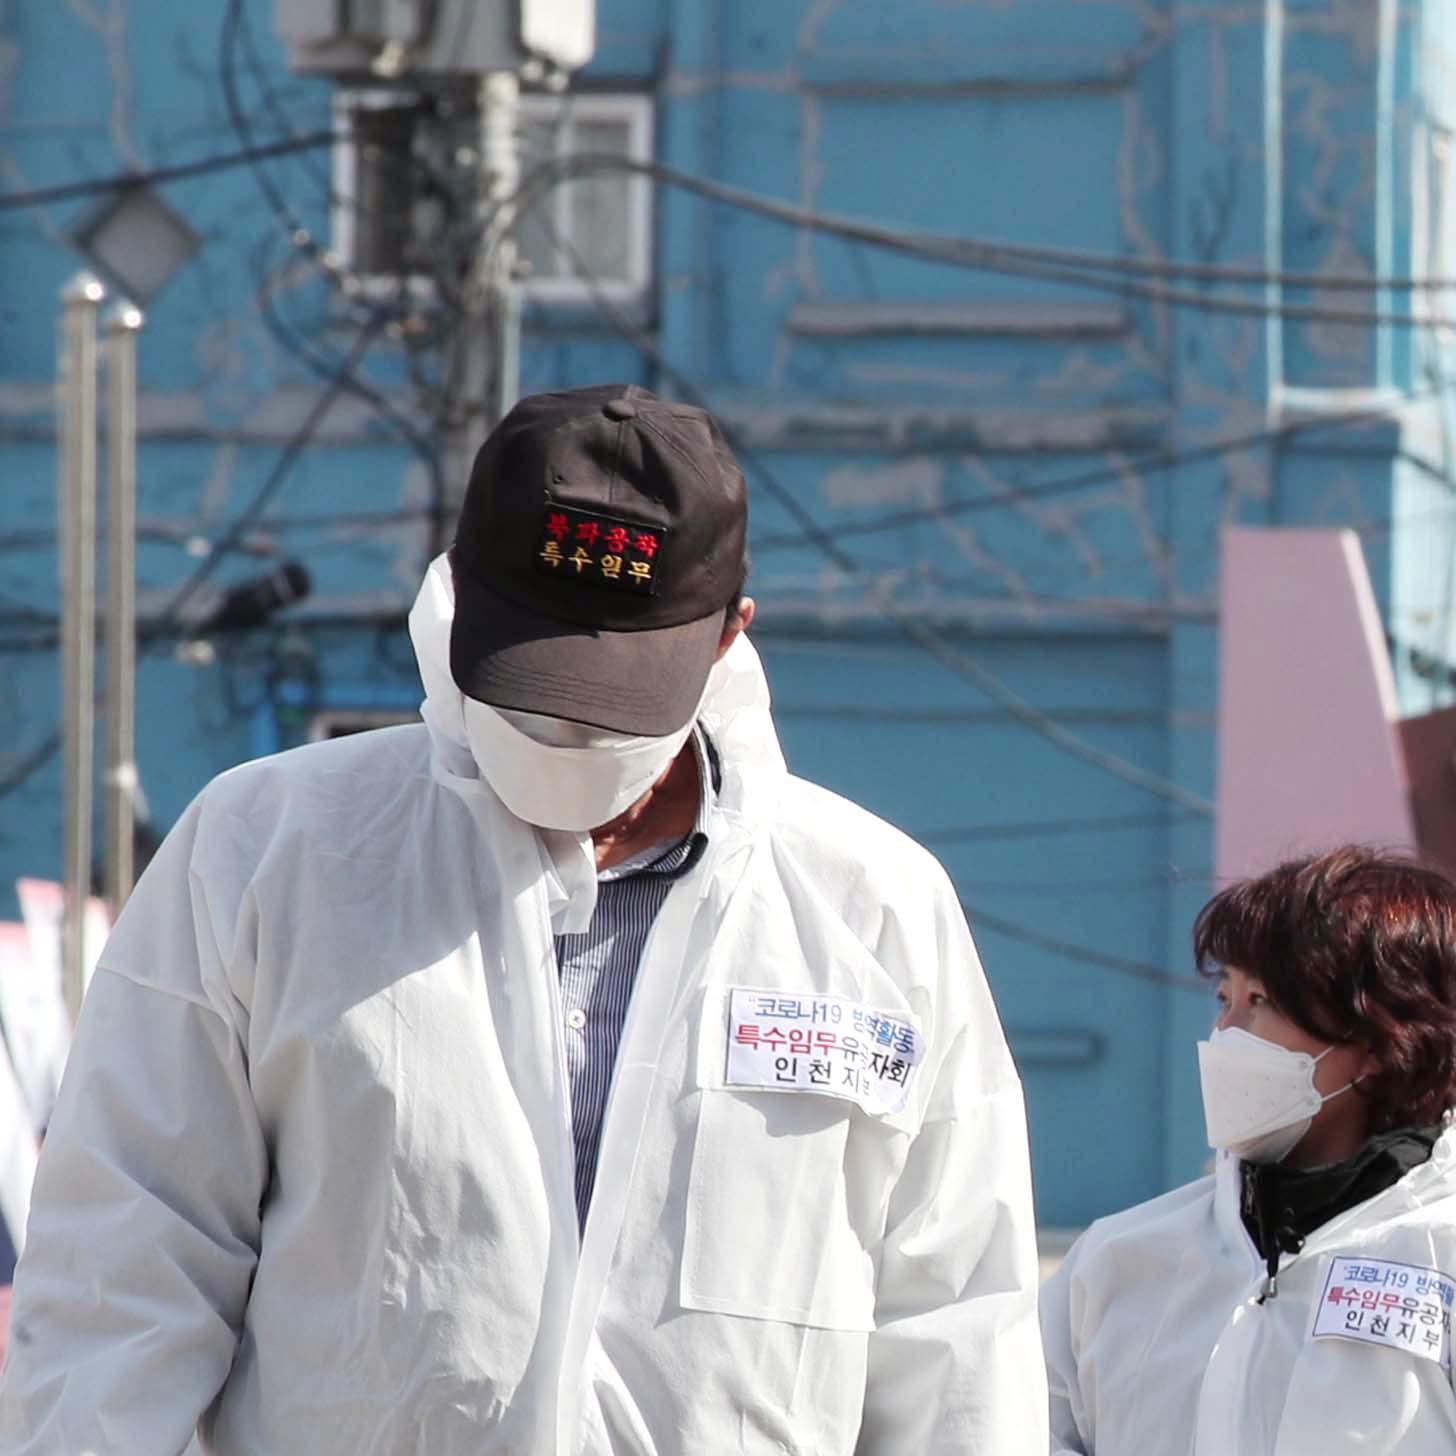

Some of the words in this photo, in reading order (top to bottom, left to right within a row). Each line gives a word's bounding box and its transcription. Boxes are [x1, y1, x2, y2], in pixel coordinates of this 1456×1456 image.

[544, 511, 660, 558] 북파공작
[538, 540, 653, 584] 특수임무
[754, 997, 843, 1025] 코로나19
[852, 1008, 916, 1055] 방역활동
[1343, 1264, 1409, 1289] 코로나19
[1327, 1285, 1451, 1335] 특수임무유공자
[1344, 1310, 1441, 1351] 인천지부
